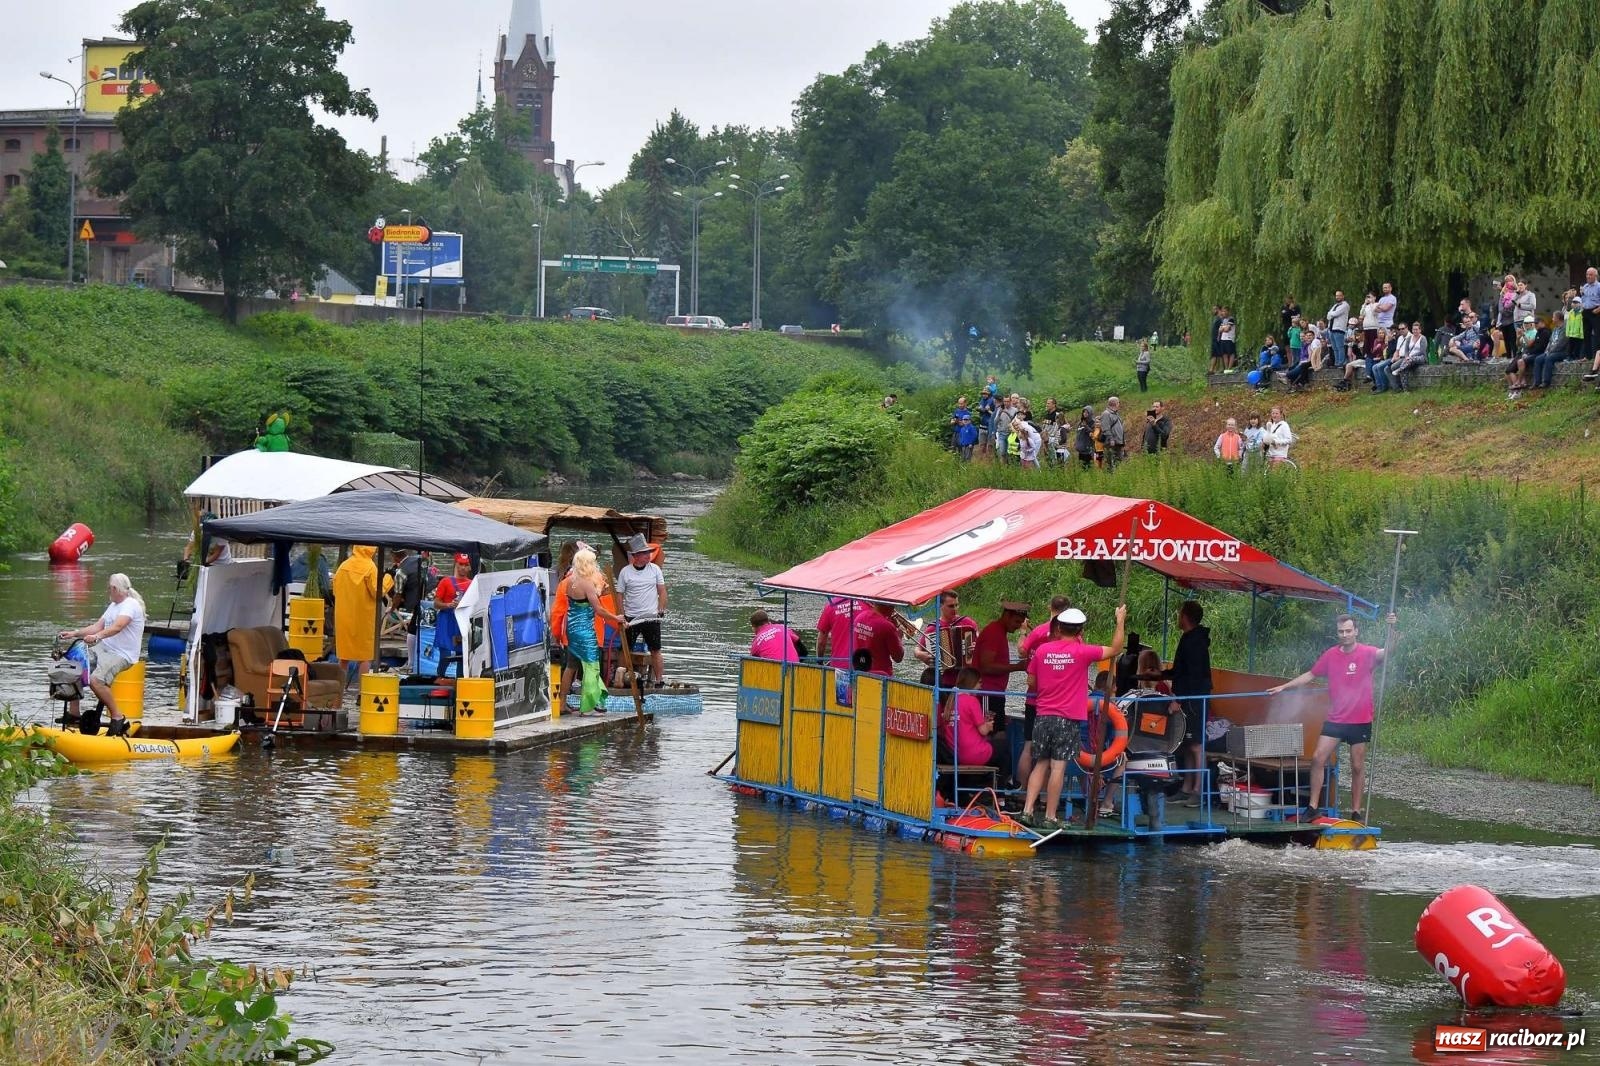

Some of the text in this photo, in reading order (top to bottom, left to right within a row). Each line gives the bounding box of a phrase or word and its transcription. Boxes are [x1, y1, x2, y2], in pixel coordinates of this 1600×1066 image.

[386, 228, 420, 236] Biedronka
[1054, 532, 1241, 562] BŁAŻEJOWICE
[133, 743, 176, 754] POLA-ONE
